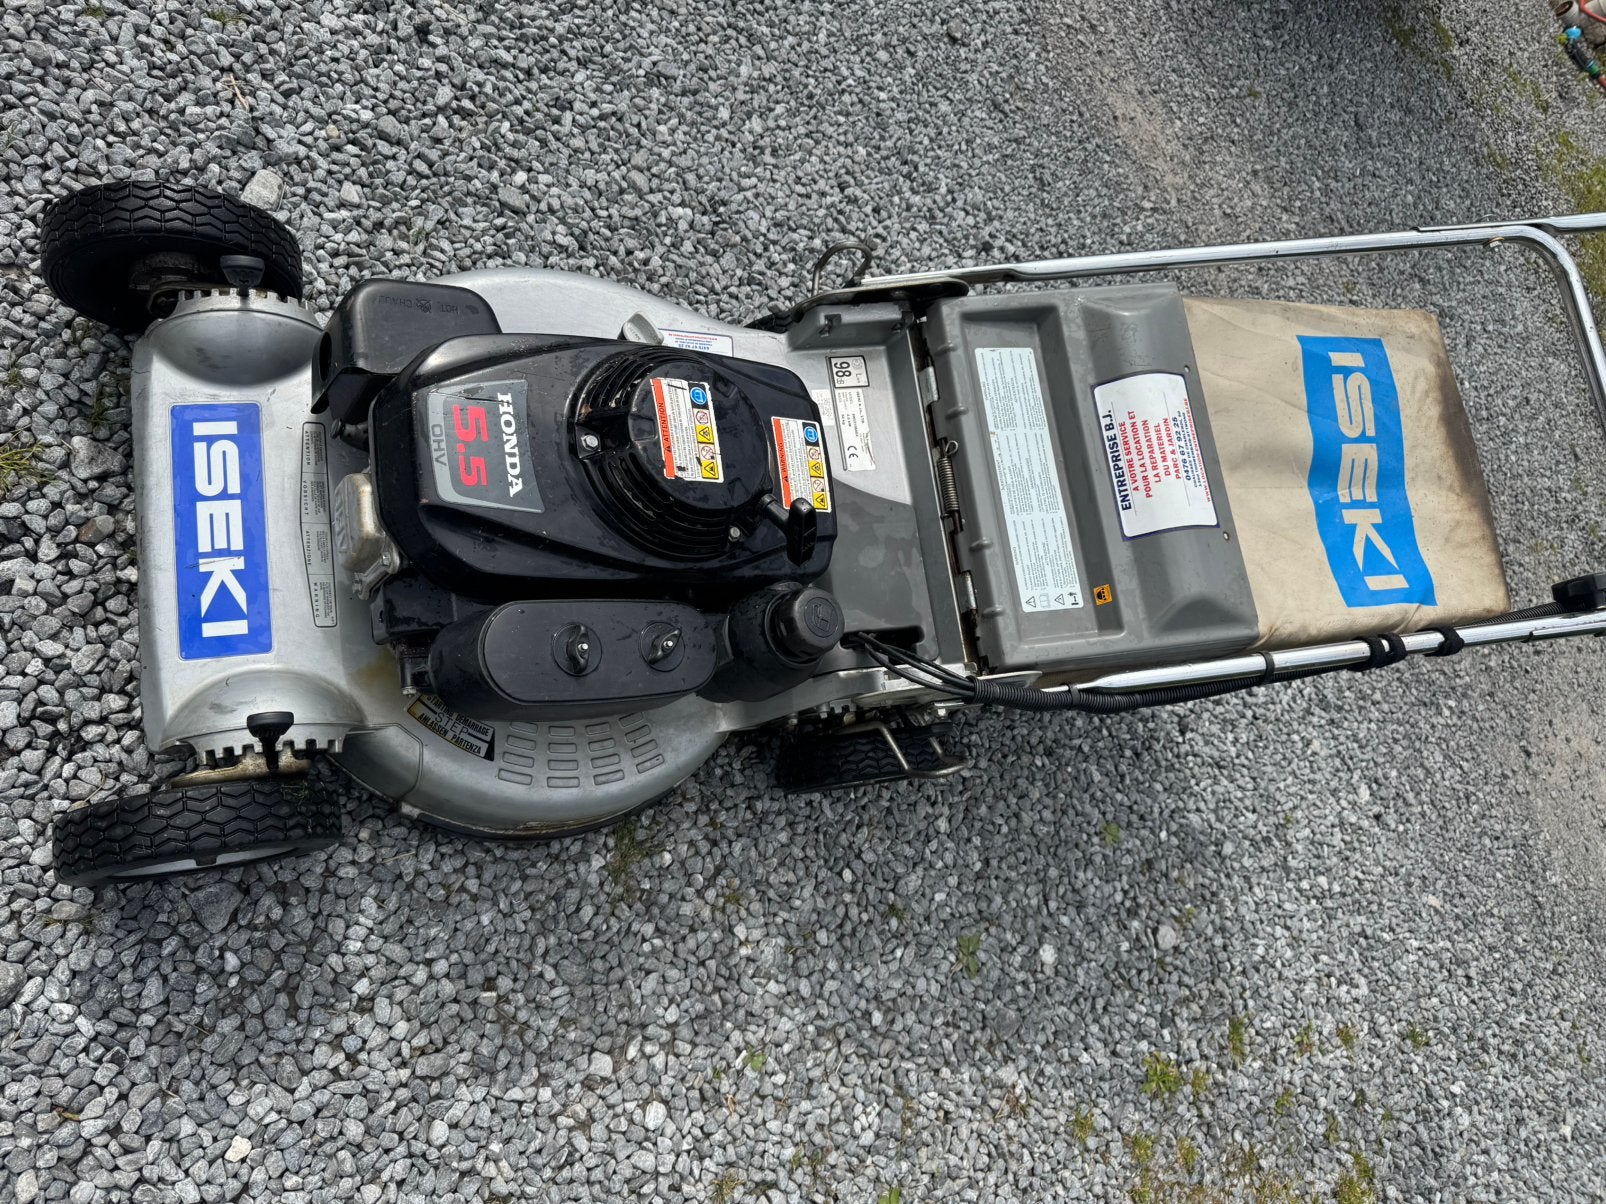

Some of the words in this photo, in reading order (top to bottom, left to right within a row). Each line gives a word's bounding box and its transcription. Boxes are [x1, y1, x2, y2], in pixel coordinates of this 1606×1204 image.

[834, 362, 851, 377] 98
[659, 402, 669, 442] ATTENTION
[1102, 410, 1115, 431] B.J.
[1128, 410, 1136, 420] ET
[1172, 417, 1180, 428] 25
[432, 424, 446, 466] OHV
[453, 405, 488, 487] 5.5
[497, 393, 523, 497] HONDA
[1119, 421, 1132, 456] SERVICE
[1131, 422, 1146, 460] LOCATION
[1141, 419, 1159, 470] REPARATION
[1154, 423, 1169, 462] MATERIEL
[1163, 418, 1175, 447] JARDIN
[1176, 430, 1183, 442] 92
[778, 442, 787, 472] WARNING
[1178, 444, 1186, 456] 67
[1107, 433, 1132, 511] ENTREPRISE
[1126, 458, 1139, 484] VOTRE
[1139, 462, 1148, 472] LA
[1153, 473, 1161, 483] LA
[1163, 464, 1171, 476] DU
[1171, 457, 1182, 479] PARC
[1180, 459, 1191, 481] 0476
[1328, 352, 1409, 590] ISEKI
[1141, 475, 1153, 498] POUR
[193, 421, 249, 637] ISEKI
[418, 713, 449, 737] ANLASSEN
[451, 735, 482, 754] PARTENZA
[435, 712, 468, 735] STEP
